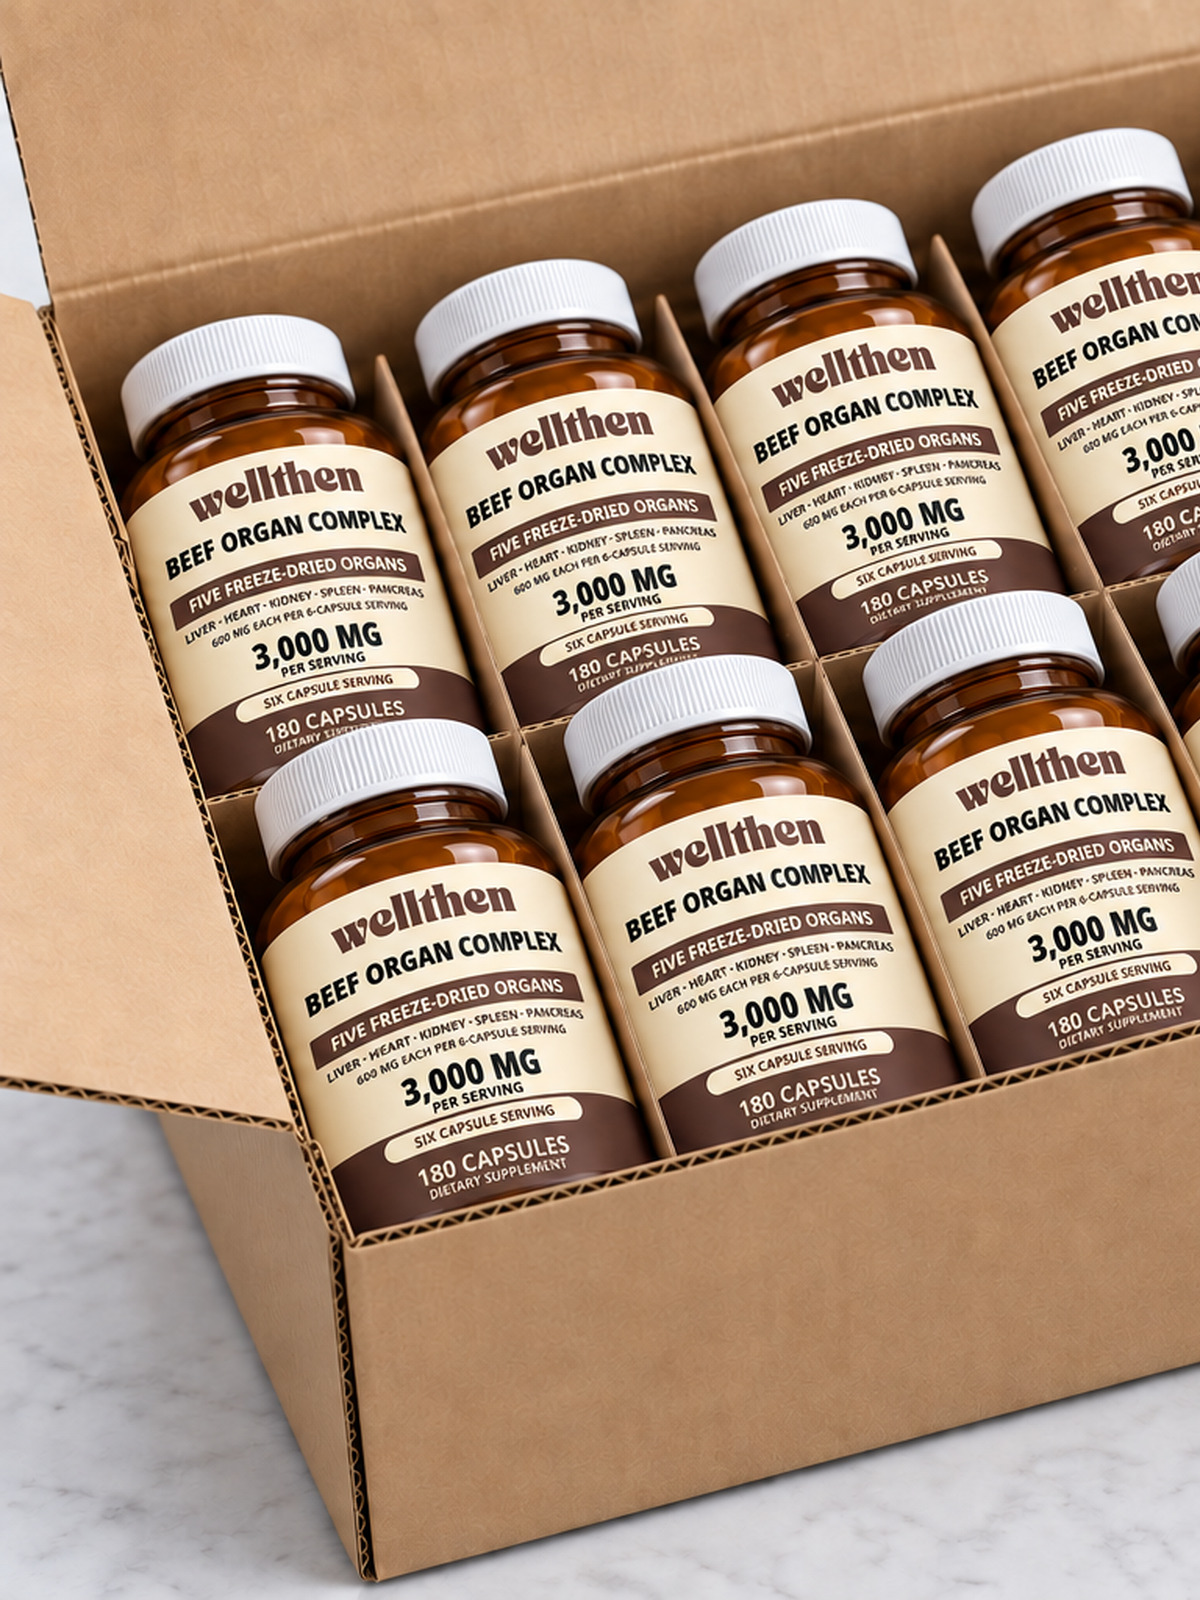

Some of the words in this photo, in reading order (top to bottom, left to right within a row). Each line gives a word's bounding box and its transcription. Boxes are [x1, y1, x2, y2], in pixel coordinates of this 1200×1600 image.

[771, 343, 936, 408] wellthen
[1032, 349, 1077, 390] BEEF
[1082, 320, 1160, 361] ORGAN
[1058, 395, 1088, 421] FIVE
[1089, 359, 1194, 404] FREEZE-DRIED
[486, 406, 654, 471] wellthen
[753, 423, 799, 464] BEEF
[804, 396, 882, 436] ORGAN
[885, 388, 979, 411] COMPLEX
[1122, 428, 1195, 473] 3,000
[189, 461, 364, 522] wellthen
[466, 487, 513, 529] BEEF
[518, 460, 597, 500] ORGAN
[601, 453, 697, 476] COMPLEX
[779, 471, 810, 497] FIVE
[811, 437, 915, 481] FREEZE-DRIED
[918, 432, 982, 448] ORGANS
[165, 539, 214, 580] BEEF
[221, 515, 304, 552] ORGAN
[308, 510, 407, 533] COMPLEX
[490, 535, 521, 561] FIVE
[523, 502, 630, 545] FREEZE-DRIED
[634, 498, 699, 513] ORGANS
[842, 507, 913, 550] 3,000
[918, 498, 965, 526] MG
[1143, 516, 1175, 540] 180
[189, 587, 222, 613] FIVE
[225, 558, 337, 597] FREEZE-DRIED
[340, 556, 407, 572] ORGANS
[552, 572, 626, 616] 3,000
[631, 564, 677, 593] MG
[861, 592, 892, 614] 180
[897, 569, 989, 602] CAPSULES
[251, 628, 329, 670] 3,000
[335, 622, 383, 649] MG
[569, 659, 601, 682] 180
[606, 636, 701, 669] CAPSULES
[266, 719, 300, 742] 180
[306, 700, 405, 729] CAPSULES
[955, 746, 1126, 812] wellthen
[648, 815, 826, 882] wellthen
[934, 829, 983, 871] BEEF
[989, 801, 1070, 842] ORGAN
[1074, 793, 1171, 817] COMPLEX
[960, 878, 993, 905] FIVE
[995, 843, 1105, 888] FREEZE-DRIED
[1109, 838, 1174, 854] ORGANS
[331, 883, 516, 954] wellthen
[625, 899, 677, 943] BEEF
[683, 872, 766, 913] ORGAN
[771, 863, 871, 888] COMPLEX
[652, 950, 686, 978] FIVE
[688, 916, 802, 961] FREEZE-DRIED
[805, 911, 873, 927] ORGANS
[1027, 916, 1105, 963] 3,000
[1109, 907, 1158, 937] MG
[304, 971, 359, 1018] BEEF
[366, 940, 454, 985] ORGAN
[459, 931, 562, 957] COMPLEX
[331, 1022, 367, 1052] FIVE
[370, 983, 490, 1032] FREEZE-DRIED
[494, 978, 563, 995] ORGANS
[719, 992, 799, 1038] 3,000
[804, 982, 854, 1014] MG
[750, 1030, 776, 1047] PER
[778, 1015, 837, 1038] SERVING
[1048, 1012, 1082, 1037] 180
[1087, 987, 1185, 1022] CAPSULES
[401, 1058, 484, 1107] 3,000
[490, 1048, 542, 1080] MG
[432, 1096, 459, 1114] PER
[462, 1081, 524, 1104] SERVING
[740, 1092, 775, 1116] 180
[780, 1068, 881, 1103] CAPSULES
[414, 1131, 437, 1149] SIX
[439, 1113, 498, 1139] CAPSULE
[500, 1104, 555, 1123] SERVING
[418, 1160, 456, 1186] 180
[462, 1135, 570, 1172] CAPSULES
[429, 1175, 481, 1200] DIETARY
[484, 1151, 566, 1184] SUPPLEMENT
